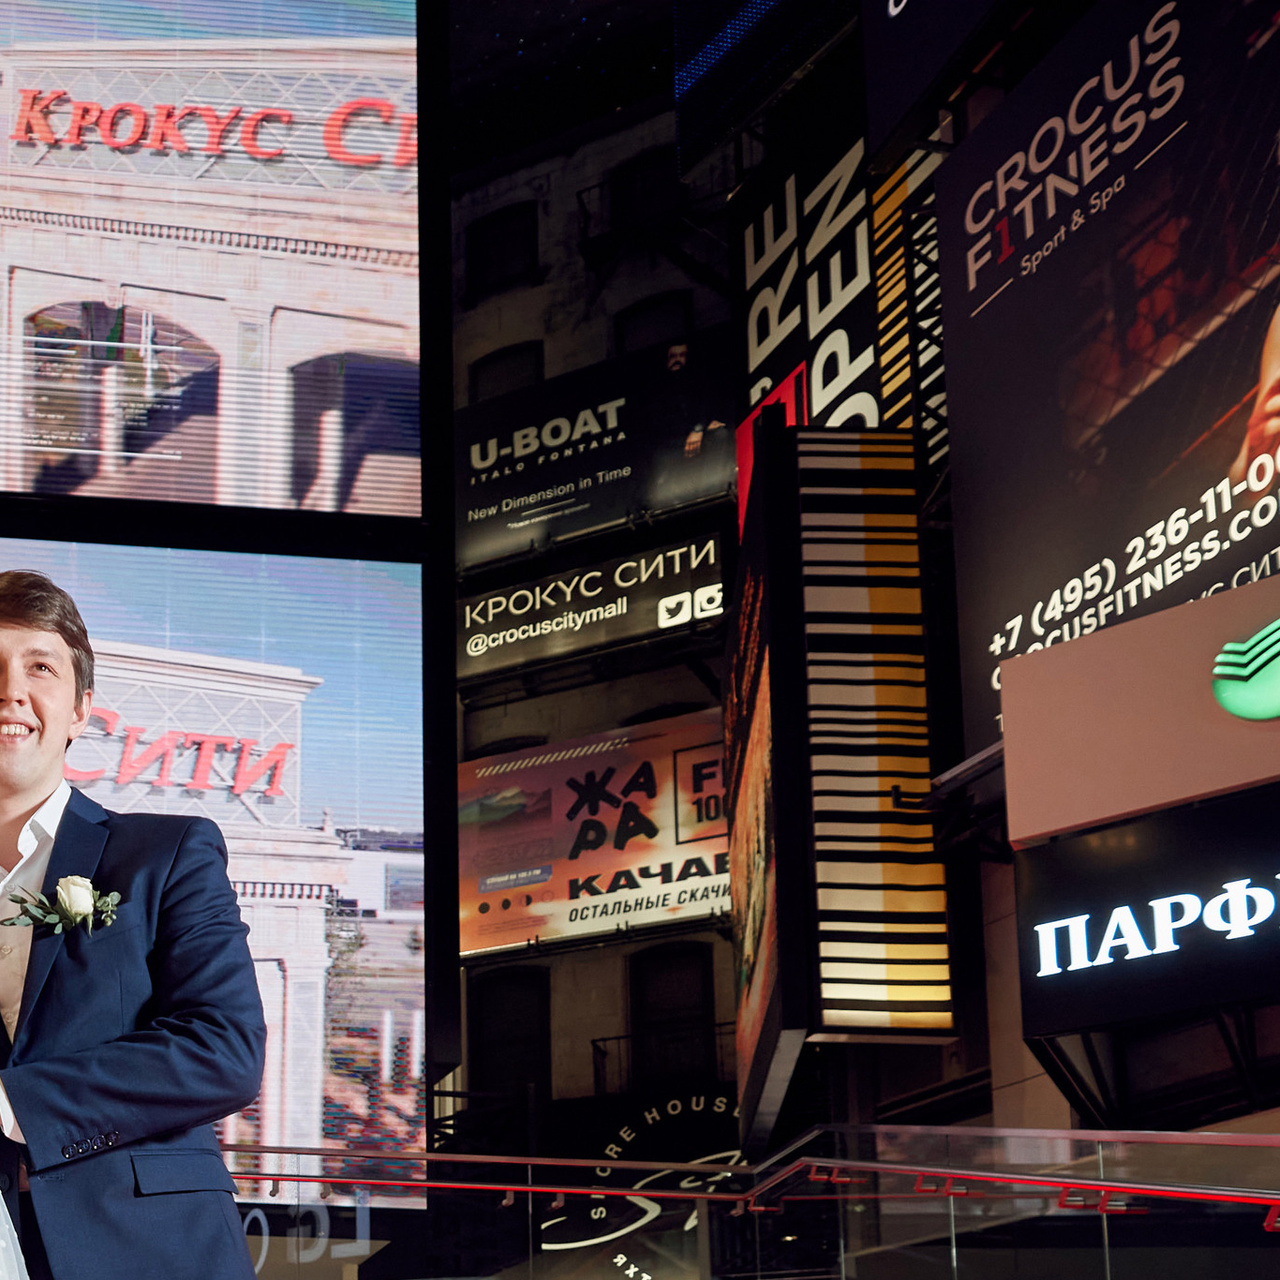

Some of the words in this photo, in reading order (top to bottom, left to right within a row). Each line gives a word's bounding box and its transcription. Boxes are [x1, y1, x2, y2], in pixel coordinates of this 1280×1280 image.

[965, 2, 1181, 235] CROCUS
[1020, 225, 1067, 277] Sport
[1071, 208, 1086, 231] &
[1089, 174, 1126, 215] Spa
[470, 397, 626, 470] U-BOAT
[470, 461, 525, 486] ITALO
[537, 431, 627, 466] FONTANA
[467, 504, 498, 522] New
[501, 481, 575, 513] Dimension
[578, 476, 593, 491] in
[596, 465, 632, 487] Time
[465, 571, 602, 629] КРОКУС
[613, 539, 715, 589] СИТИ
[988, 614, 1023, 656] +7
[1030, 557, 1117, 637] (495)
[1124, 445, 1280, 576] 236-11-0
[465, 596, 628, 657] @crocuscitymall
[565, 760, 658, 822] ЖА
[568, 801, 660, 860] РА
[568, 891, 671, 923] ОСТАЛЬНЫЕ
[1033, 872, 1280, 978] ПАРФ
